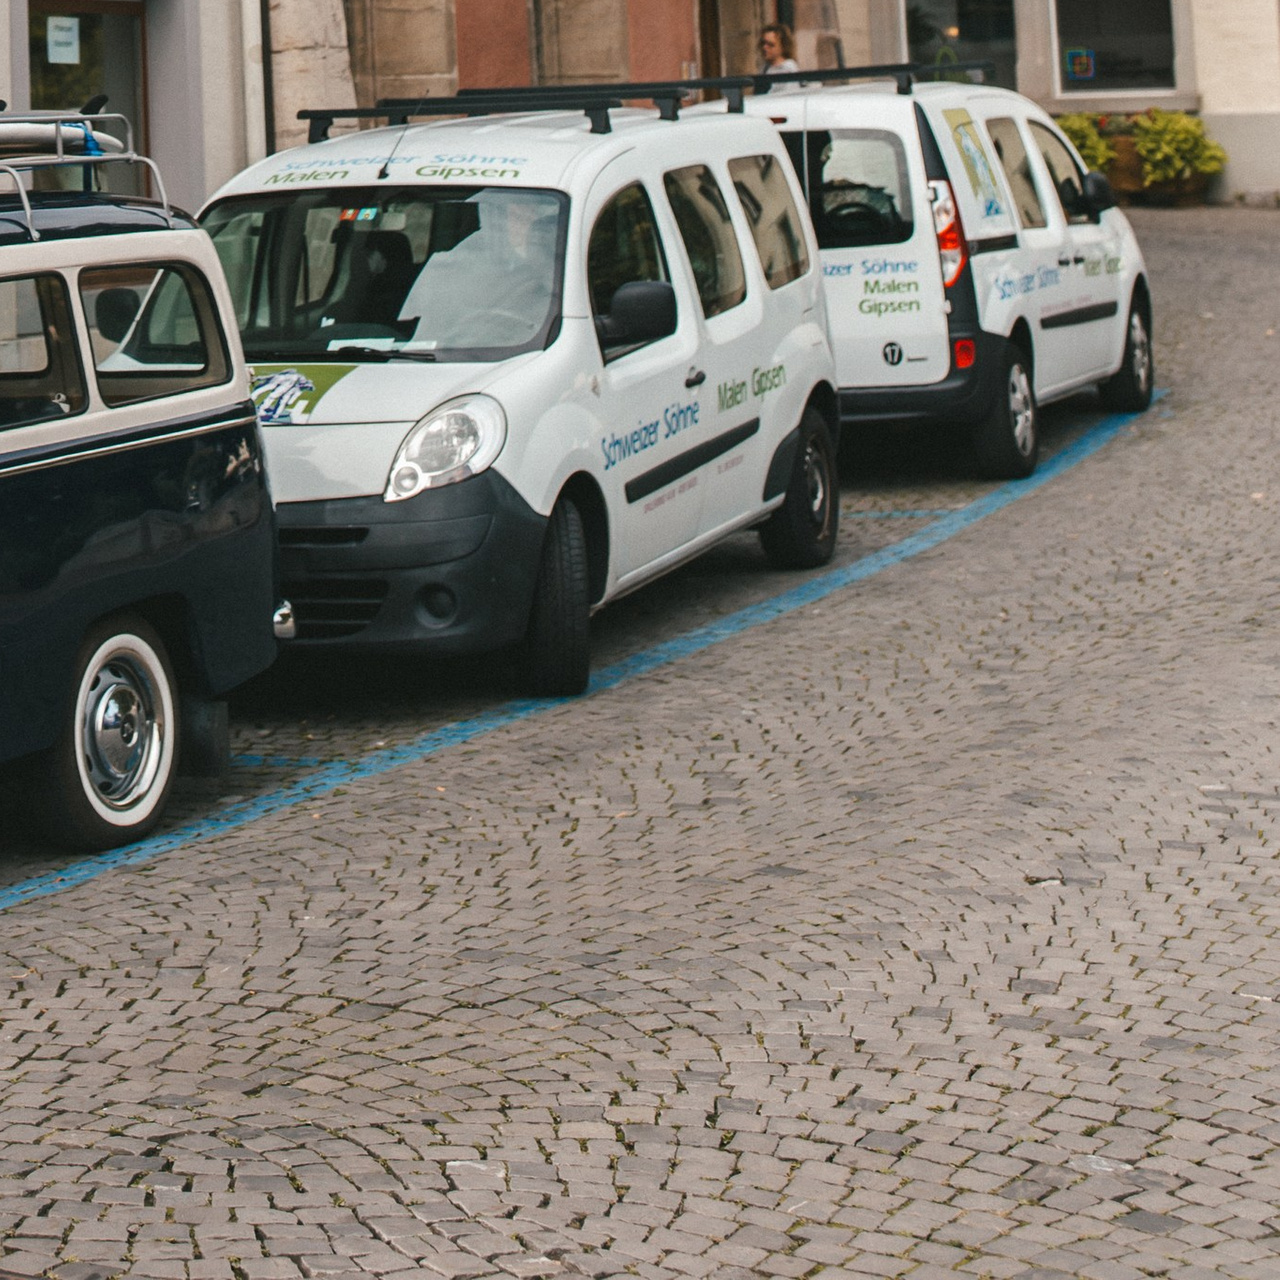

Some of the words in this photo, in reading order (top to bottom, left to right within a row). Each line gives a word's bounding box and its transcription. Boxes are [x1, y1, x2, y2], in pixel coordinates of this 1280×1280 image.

[276, 154, 423, 172] Schweizer
[429, 153, 529, 166] Söhne
[263, 168, 350, 186] Malen
[414, 164, 520, 180] Gipsen
[861, 259, 919, 276] Söhne
[864, 279, 919, 295] Malen
[858, 299, 920, 318] Gipsen
[717, 379, 749, 415] Malen
[751, 363, 787, 402] Gipsen
[601, 419, 660, 471] Schweizer
[663, 400, 701, 440] Söhne
